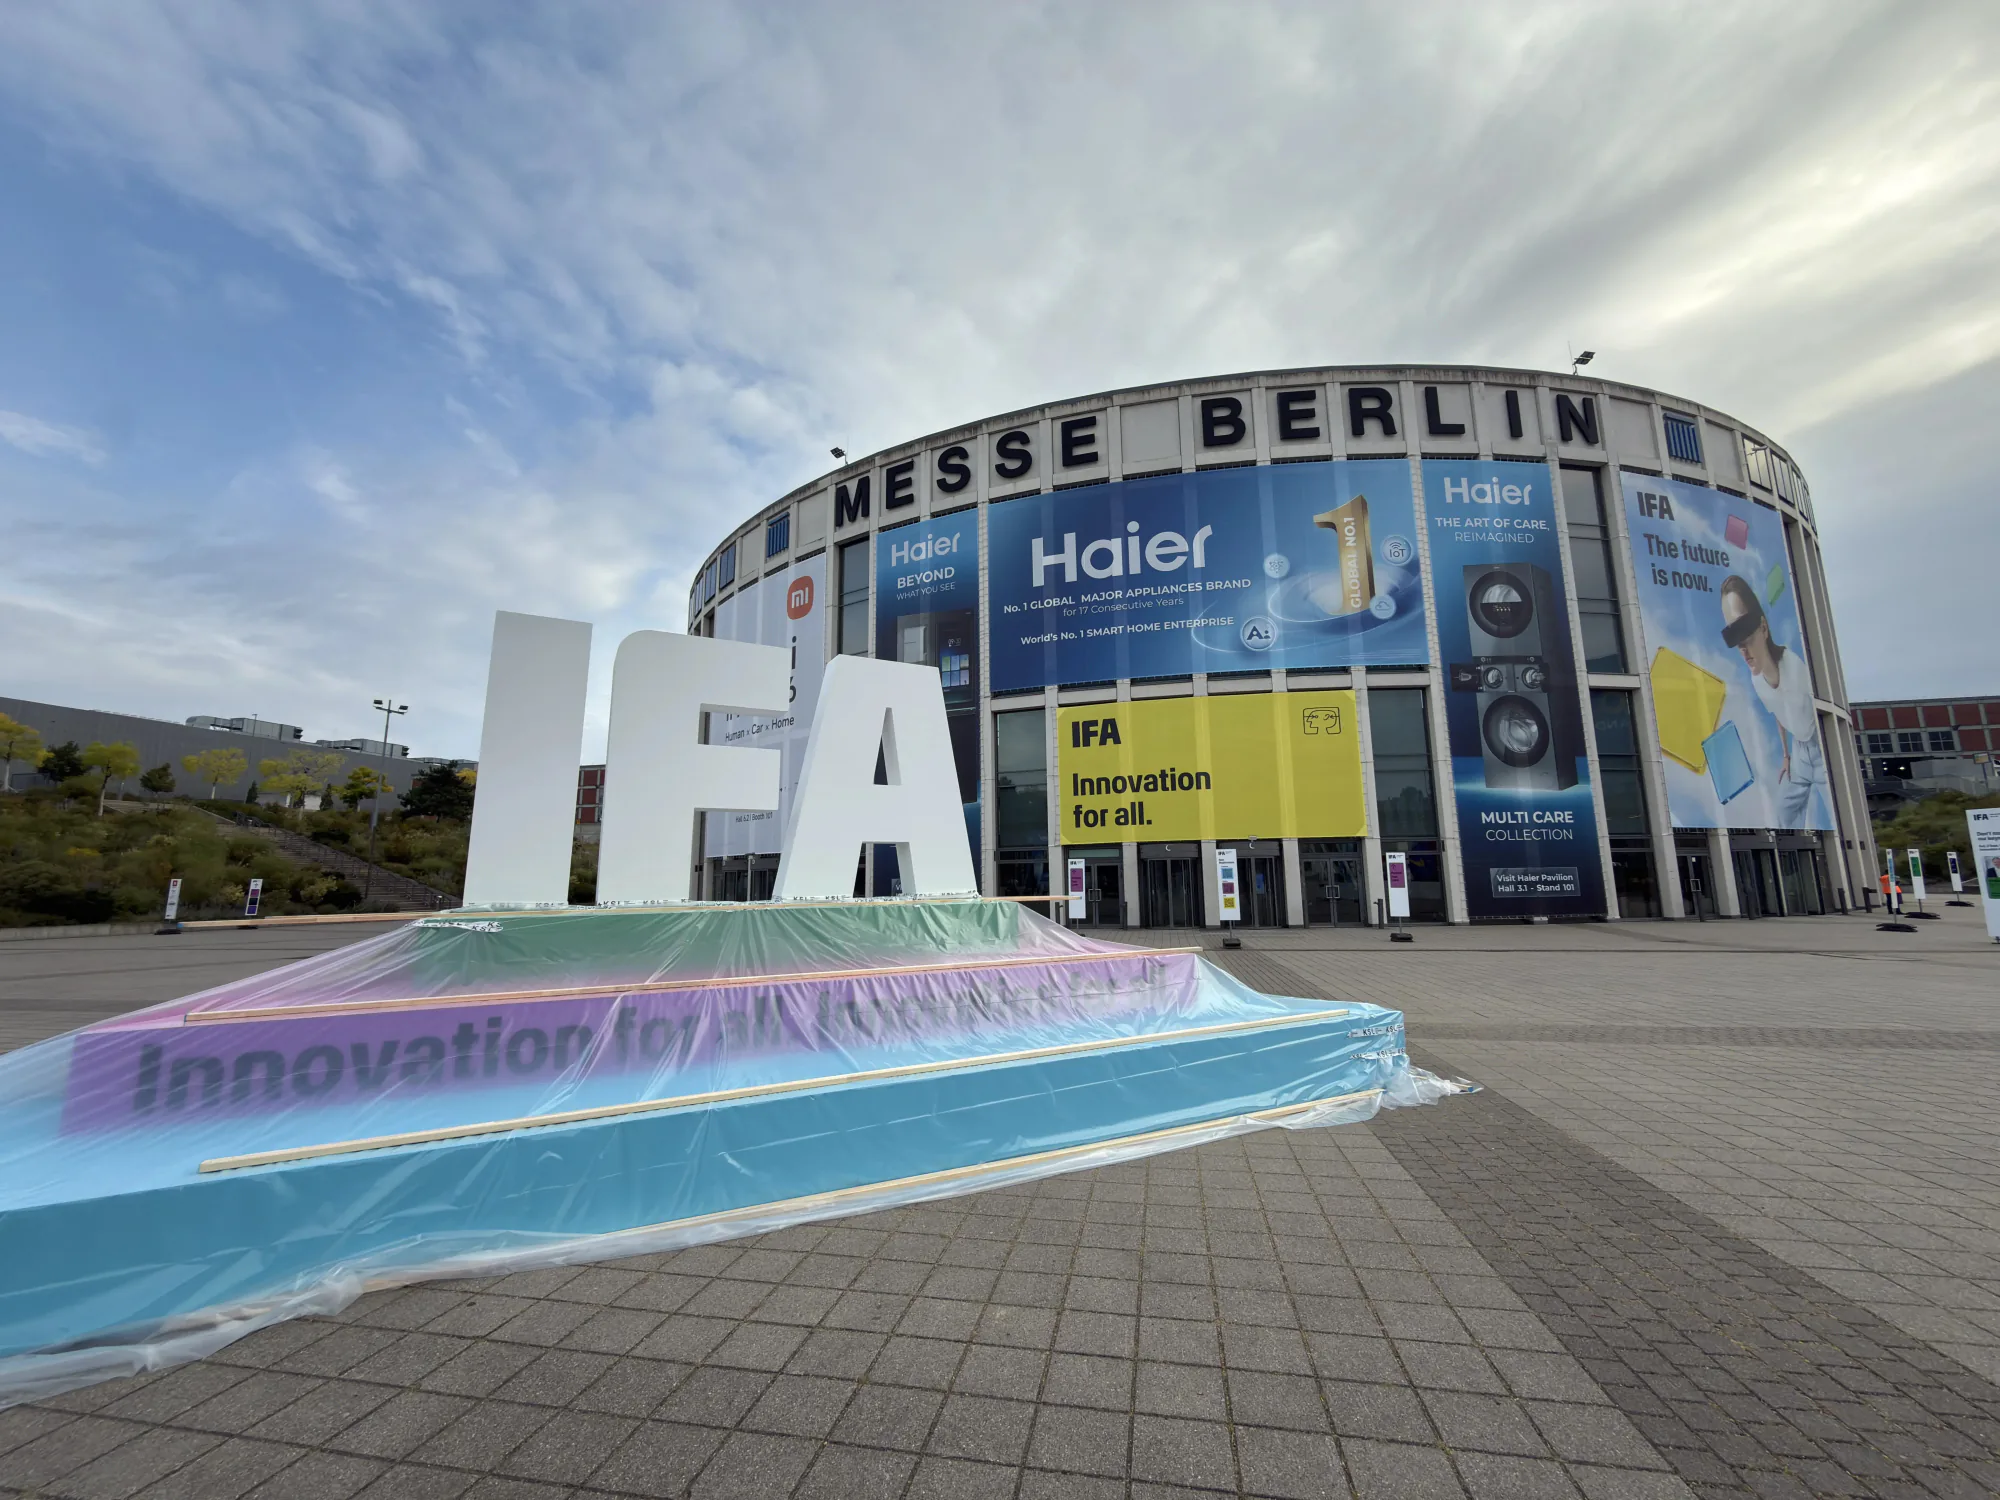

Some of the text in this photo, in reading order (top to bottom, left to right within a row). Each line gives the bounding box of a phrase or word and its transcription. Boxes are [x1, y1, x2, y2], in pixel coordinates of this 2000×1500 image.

[835, 386, 1600, 527] MESSE BERLIN
[1443, 476, 1532, 506] Haier
[1636, 491, 1675, 521] IFA
[1435, 517, 1550, 531] THE ART OF CARE,
[1454, 531, 1534, 543] REIMAGINED
[891, 532, 960, 567] Haier
[1031, 520, 1213, 587] Haier
[1343, 517, 1362, 608] GLOBAL NO.1
[1643, 533, 1730, 567] The future
[896, 581, 956, 601] WHAT YOU SEE
[897, 566, 955, 589] BEYOND
[1651, 563, 1713, 593] is now.
[1003, 603, 1021, 614] No.
[1030, 595, 1075, 610] GLOBAL
[1081, 590, 1123, 603] MAJOR
[1126, 582, 1203, 598] APPLIANCES
[1206, 578, 1251, 591] BRAND
[1063, 596, 1184, 617] for 17 Consecutive Years
[1020, 633, 1058, 646] World's
[1060, 630, 1078, 641] No.
[1086, 625, 1124, 638] SMART
[1127, 621, 1161, 634] HOME
[1164, 616, 1235, 630] ENTERPRISE
[725, 728, 745, 743] Human
[751, 723, 763, 735] Car
[771, 716, 795, 730] Home
[1071, 717, 1121, 748] IFA
[463, 609, 979, 907] IFA
[1072, 766, 1211, 797] Innovation
[1073, 801, 1153, 828] for all.
[1481, 811, 1574, 824] MULTI CARE
[1973, 813, 1989, 821] IFA
[1485, 828, 1574, 841] COLLECTION
[1496, 873, 1573, 882] Visit Haier Pavilion
[1498, 884, 1514, 892] Hall
[1517, 884, 1528, 892] 3.1
[1536, 883, 1560, 891] Stand
[1563, 883, 1575, 891] 101
[131, 1014, 595, 1115] Innovation
